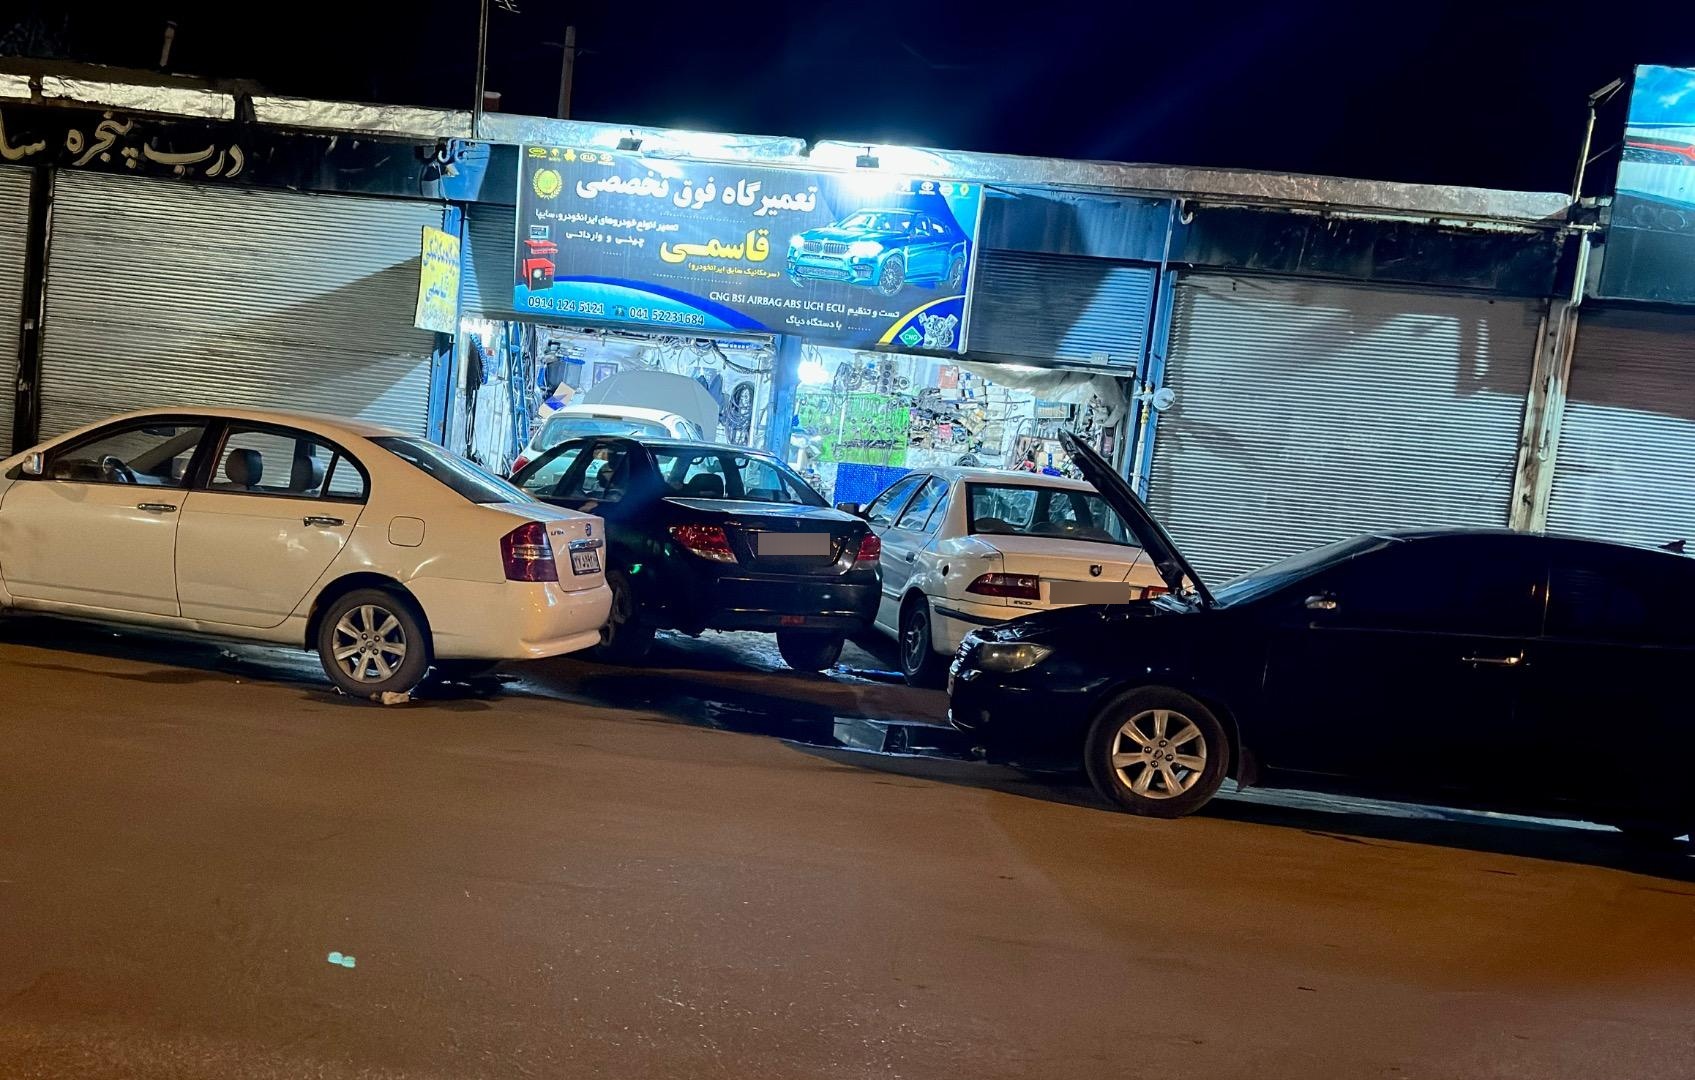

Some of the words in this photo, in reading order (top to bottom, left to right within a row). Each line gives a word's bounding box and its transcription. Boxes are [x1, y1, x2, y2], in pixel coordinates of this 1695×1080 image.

[66, 111, 139, 168] پنجره
[144, 142, 244, 178] درب
[576, 170, 670, 199] تخصصی
[673, 176, 717, 209] فوق
[722, 179, 818, 216] تعمیرگاه
[566, 230, 603, 242] وارداتی
[605, 235, 612, 243] و
[660, 228, 770, 264] قاسمی
[726, 267, 743, 275] سابق
[528, 296, 553, 308] 0914
[557, 299, 576, 312] 124
[578, 302, 604, 315] 5121
[709, 291, 730, 302] CNG
[731, 294, 745, 303] BSI
[747, 296, 782, 307] AIRBAG
[783, 299, 801, 309] ABS
[804, 301, 823, 311] UCH
[826, 303, 845, 313] ECU
[629, 307, 648, 320] 041
[652, 310, 704, 326] 52231684
[806, 318, 835, 329] دستگاه
[872, 310, 878, 318] و
[879, 310, 900, 318] تست
